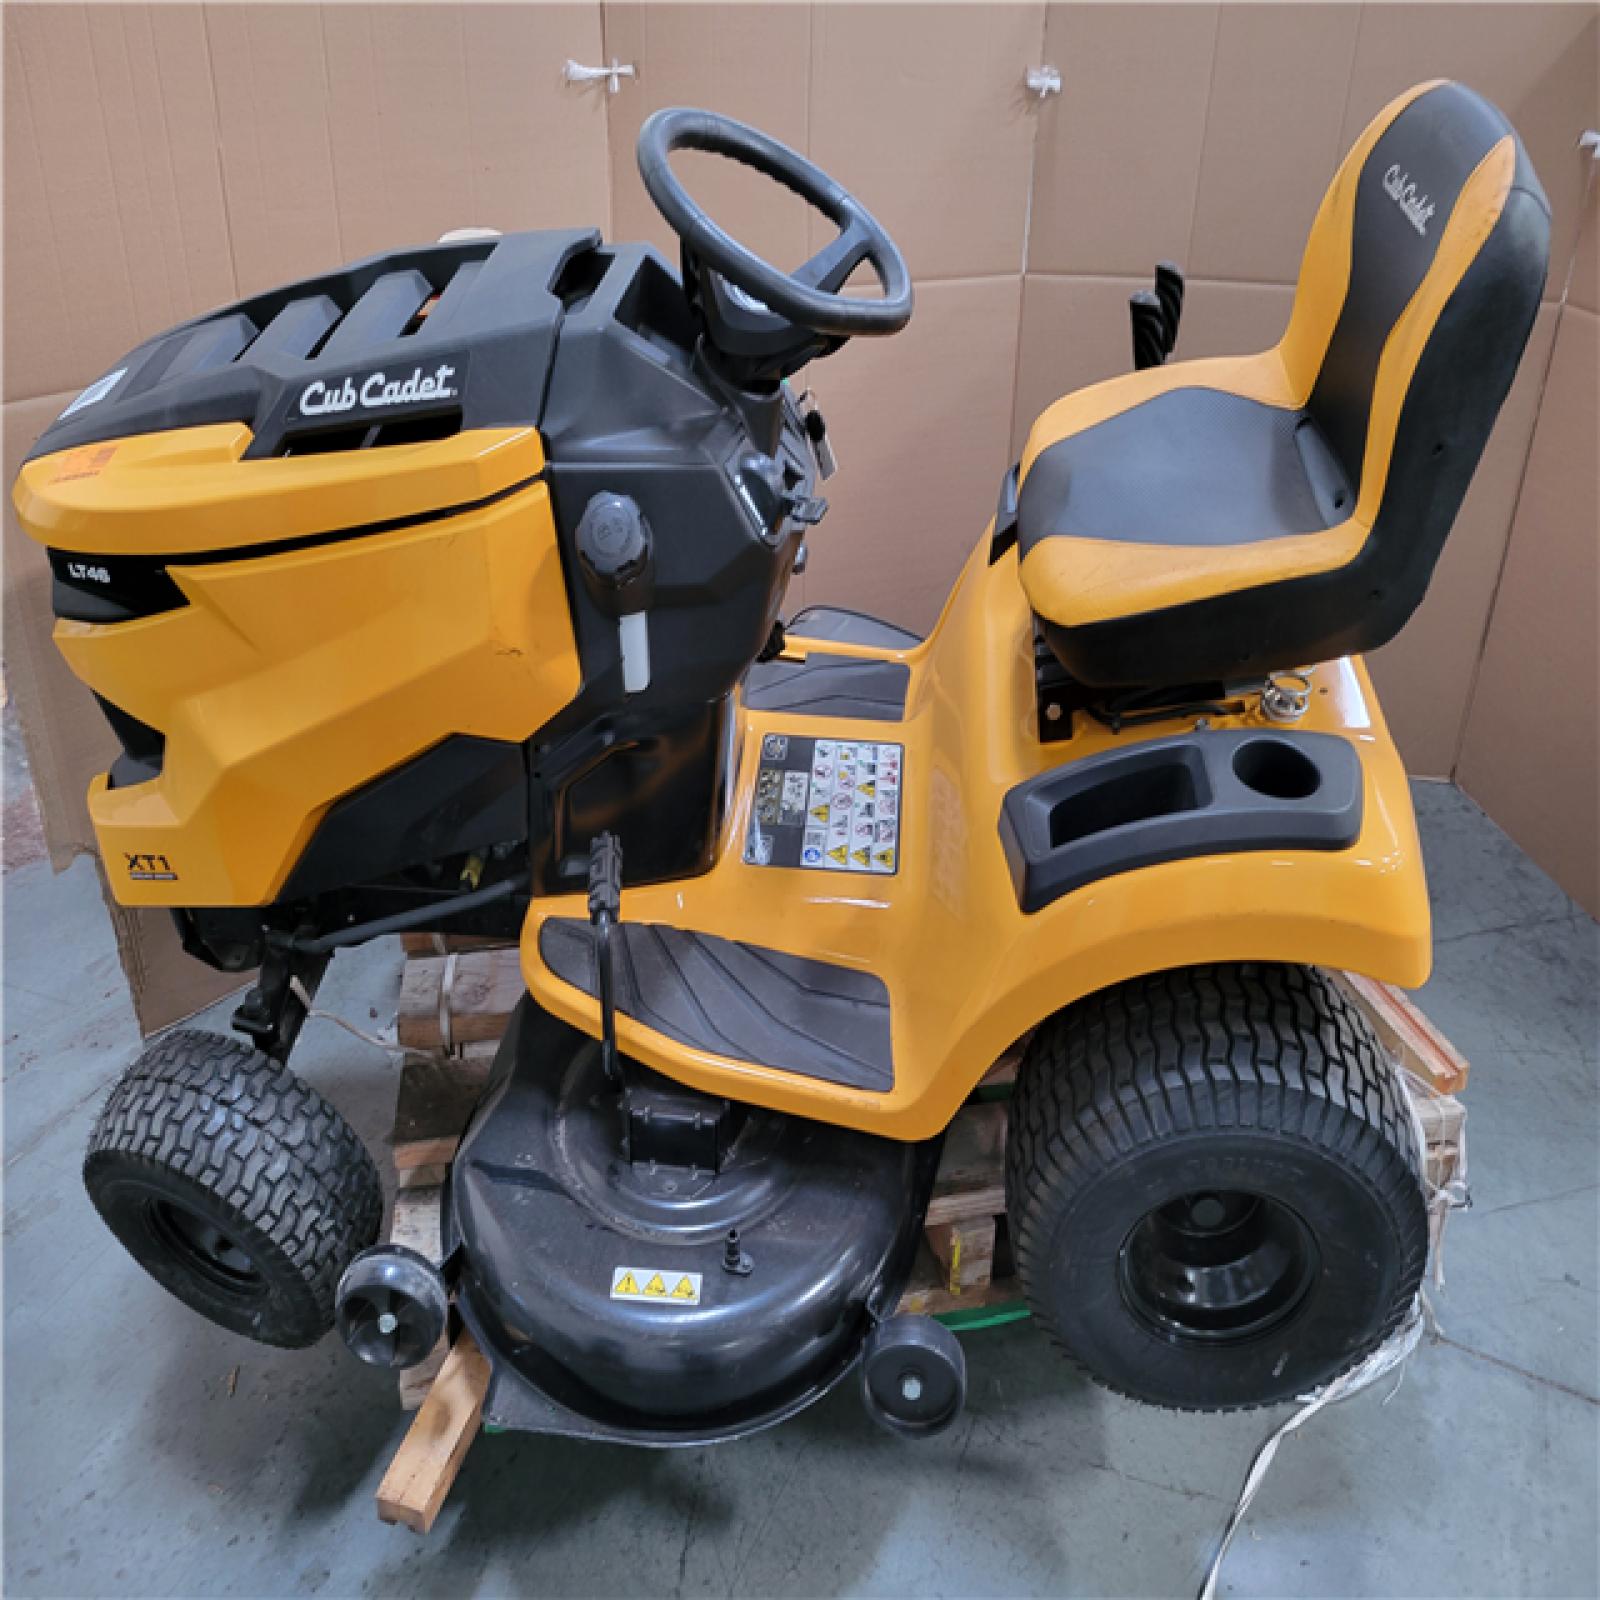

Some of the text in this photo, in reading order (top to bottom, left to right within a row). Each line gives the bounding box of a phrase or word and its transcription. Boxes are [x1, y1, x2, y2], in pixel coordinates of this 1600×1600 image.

[1383, 164, 1408, 201] Cub
[300, 364, 456, 415] Cub Cadet
[123, 852, 171, 871] XT1
